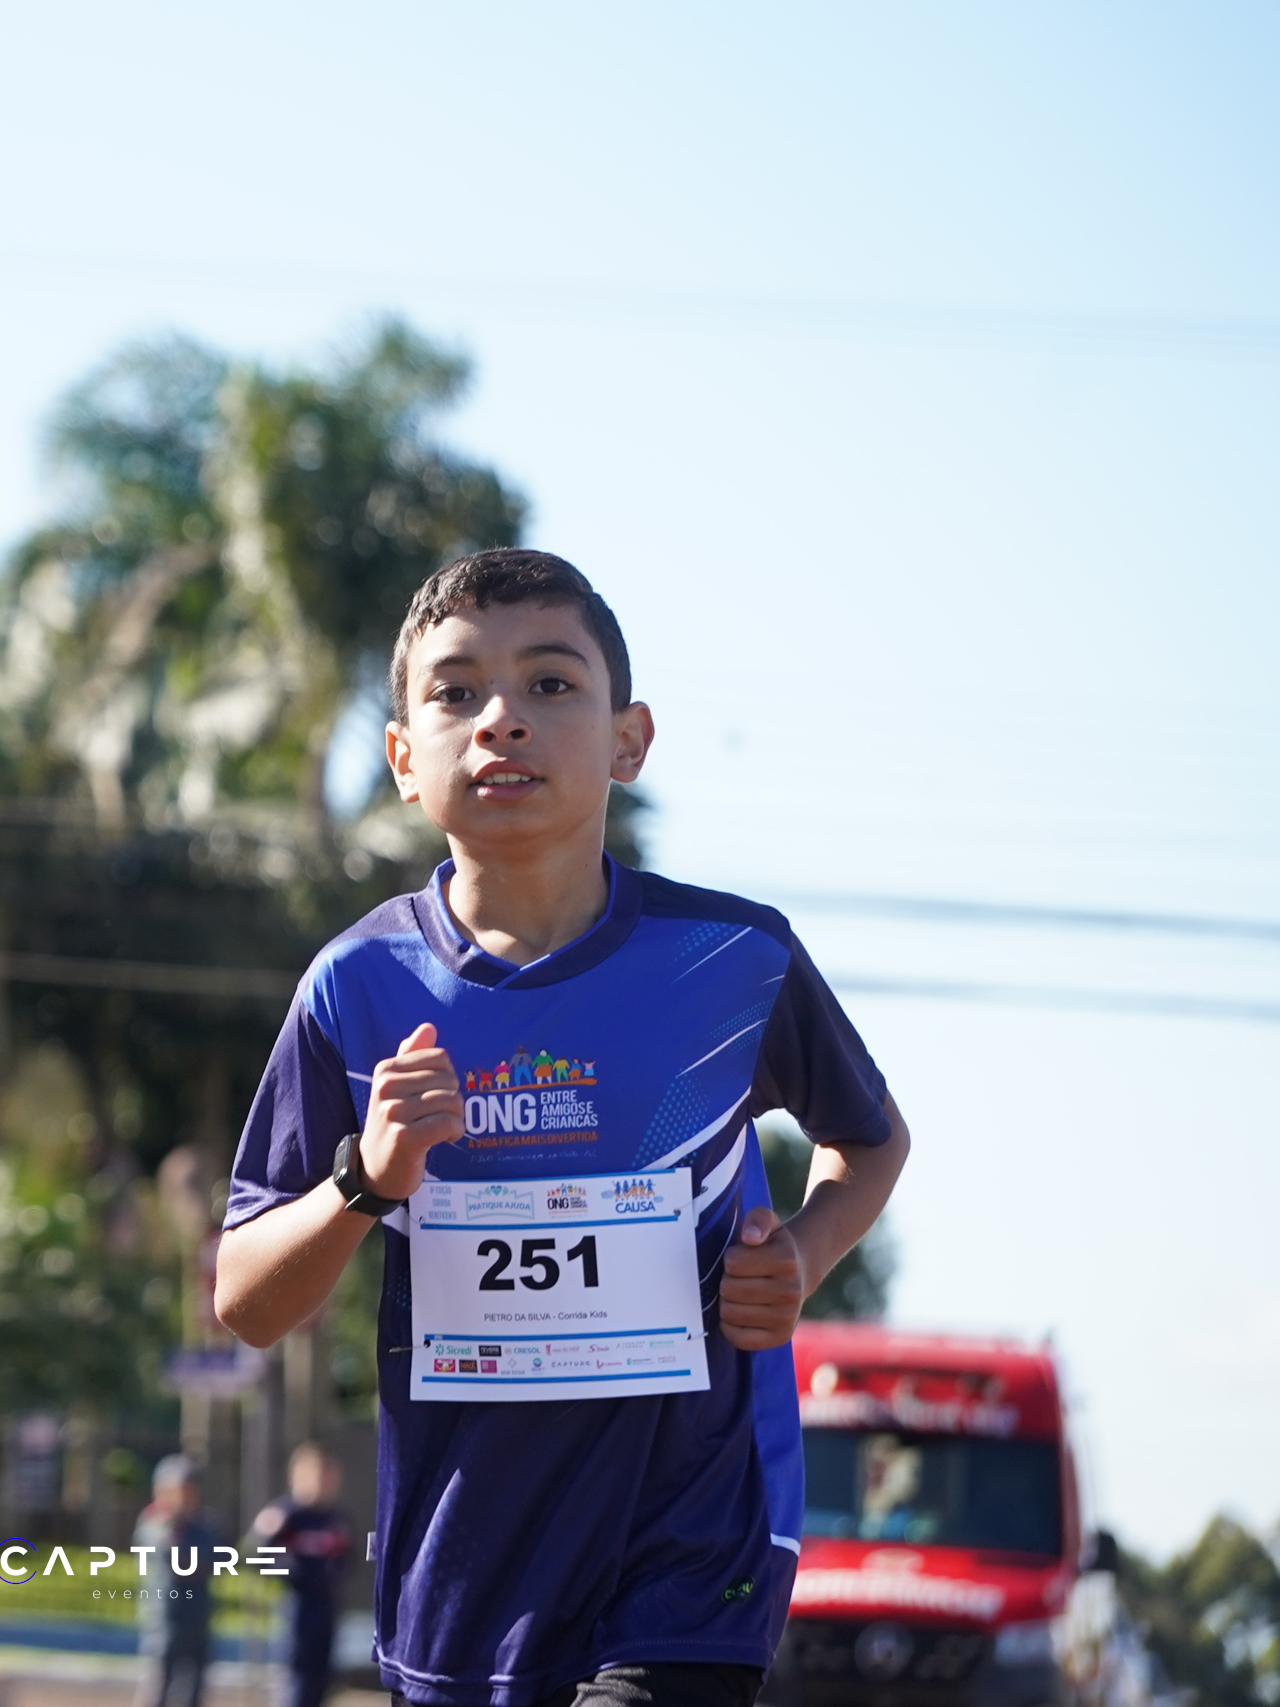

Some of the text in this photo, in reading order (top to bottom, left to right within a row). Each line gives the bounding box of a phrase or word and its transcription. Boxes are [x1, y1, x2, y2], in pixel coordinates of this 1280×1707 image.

[540, 1089, 577, 1104] ENTRE
[465, 1093, 537, 1135] ONG
[476, 1136, 498, 1148] VIDA
[500, 1135, 520, 1147] FICA
[521, 1134, 546, 1146] MAIS
[547, 1131, 598, 1144] DIVERTIDA
[468, 1201, 531, 1212] PRATIQUE AJUDA
[547, 1198, 569, 1210] ONG
[615, 1201, 656, 1214] CAUSA
[477, 1235, 599, 1291] 251
[484, 1313, 513, 1322] PIETRO
[514, 1313, 527, 1321] DA
[528, 1312, 551, 1321] SILVA
[558, 1311, 587, 1320] Corrida
[590, 1310, 607, 1319] Kids
[446, 1345, 472, 1355] Sicredi
[513, 1347, 541, 1355] CRESOL
